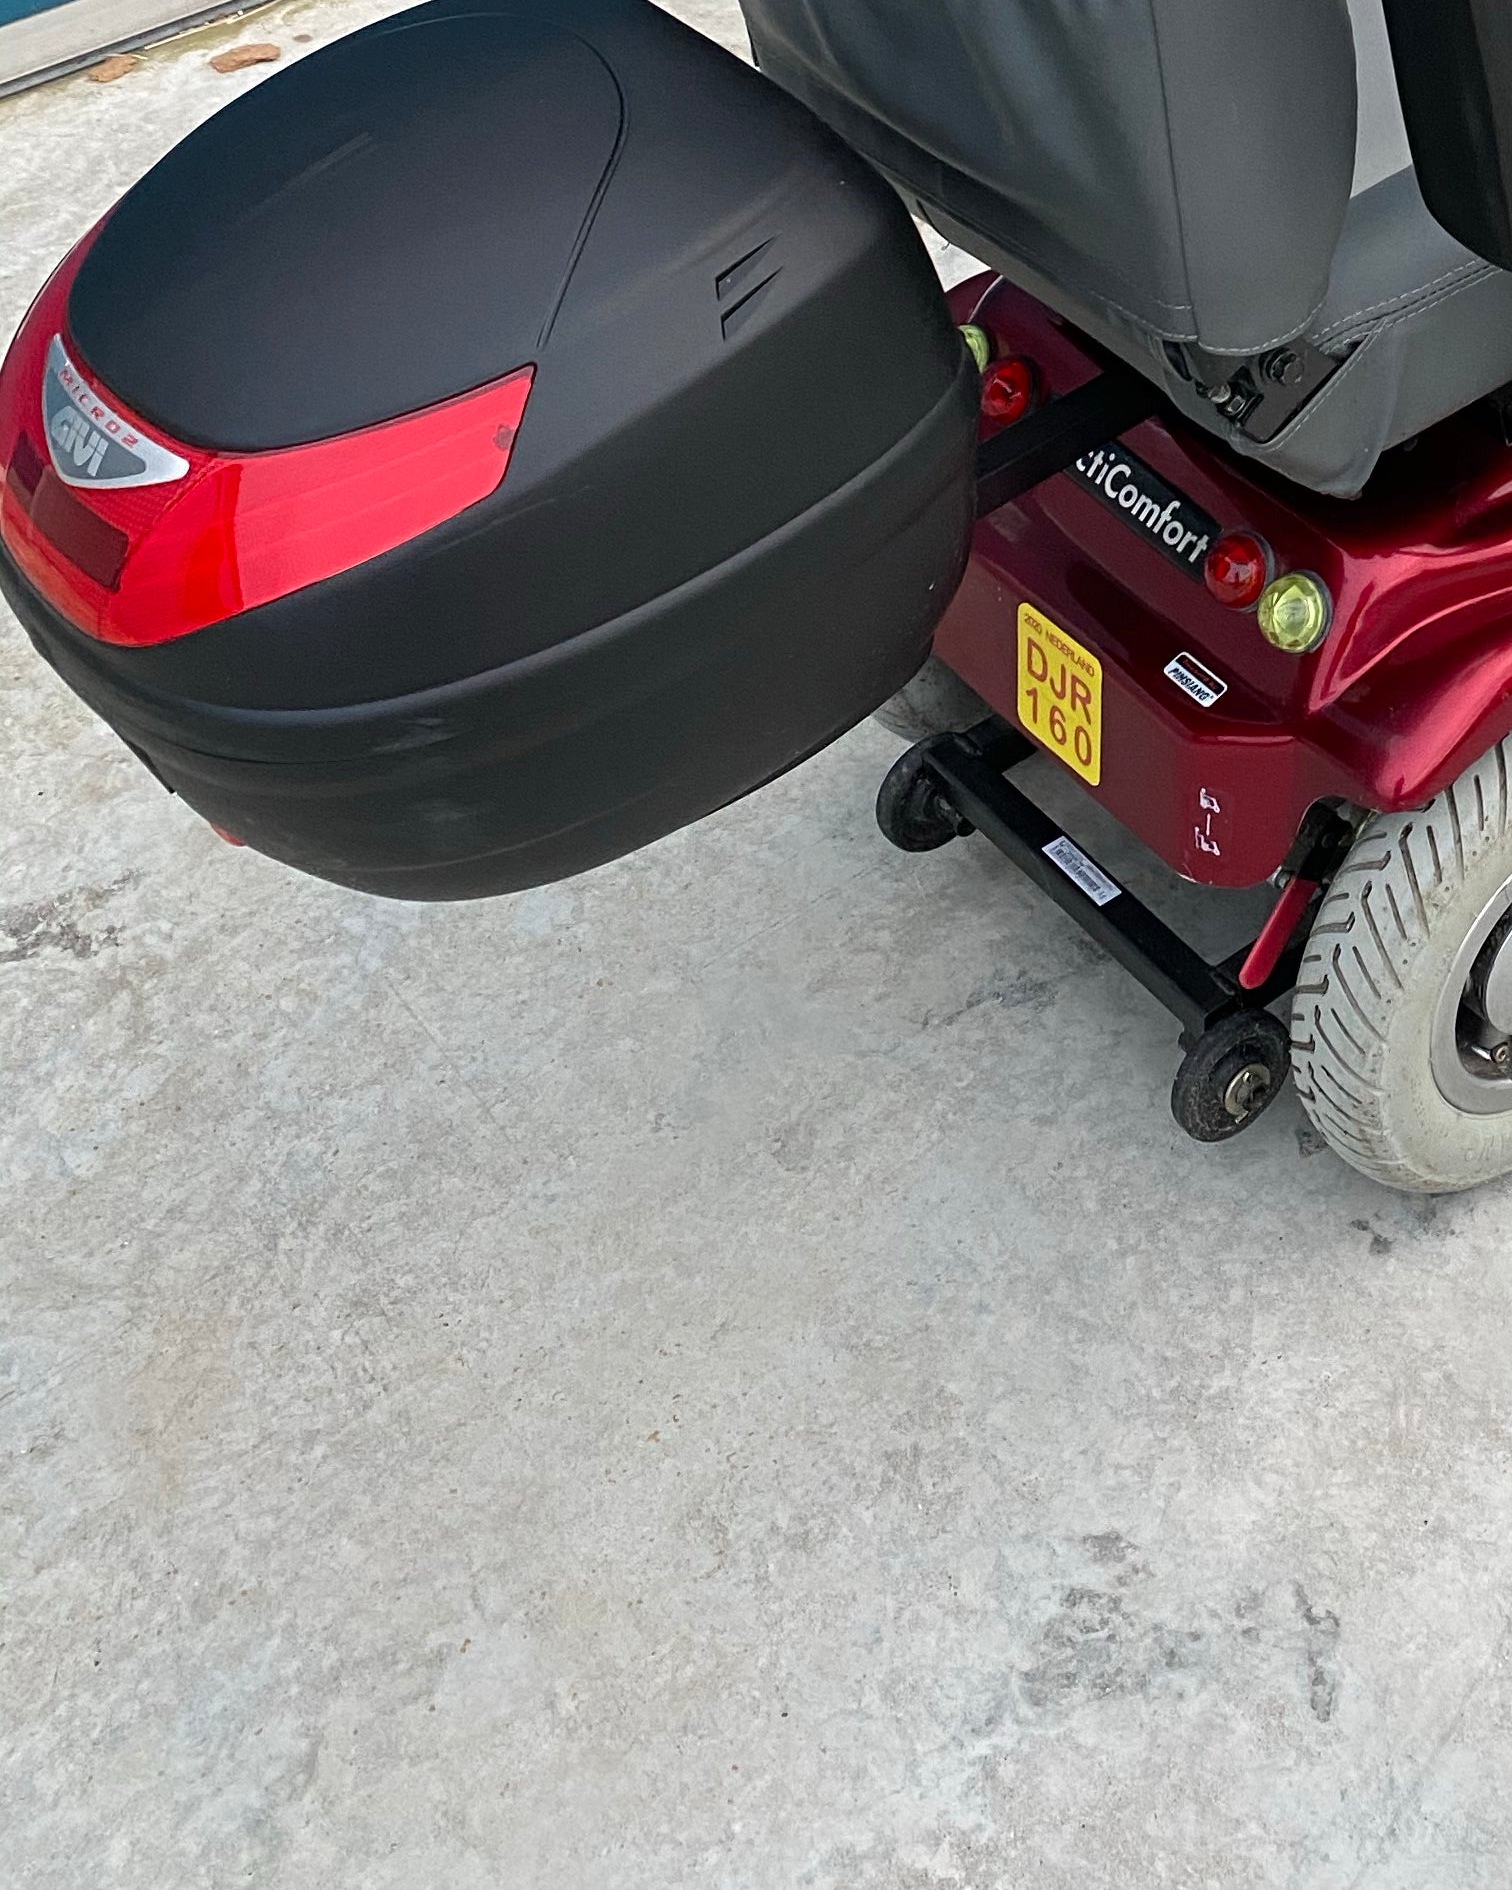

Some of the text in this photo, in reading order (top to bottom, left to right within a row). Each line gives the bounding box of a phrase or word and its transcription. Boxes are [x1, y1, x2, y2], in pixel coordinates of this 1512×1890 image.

[51, 405, 109, 477] GIVI
[1027, 637, 1091, 726] DJR
[1045, 630, 1095, 677] NEDERLAND
[1026, 687, 1092, 767] 160
